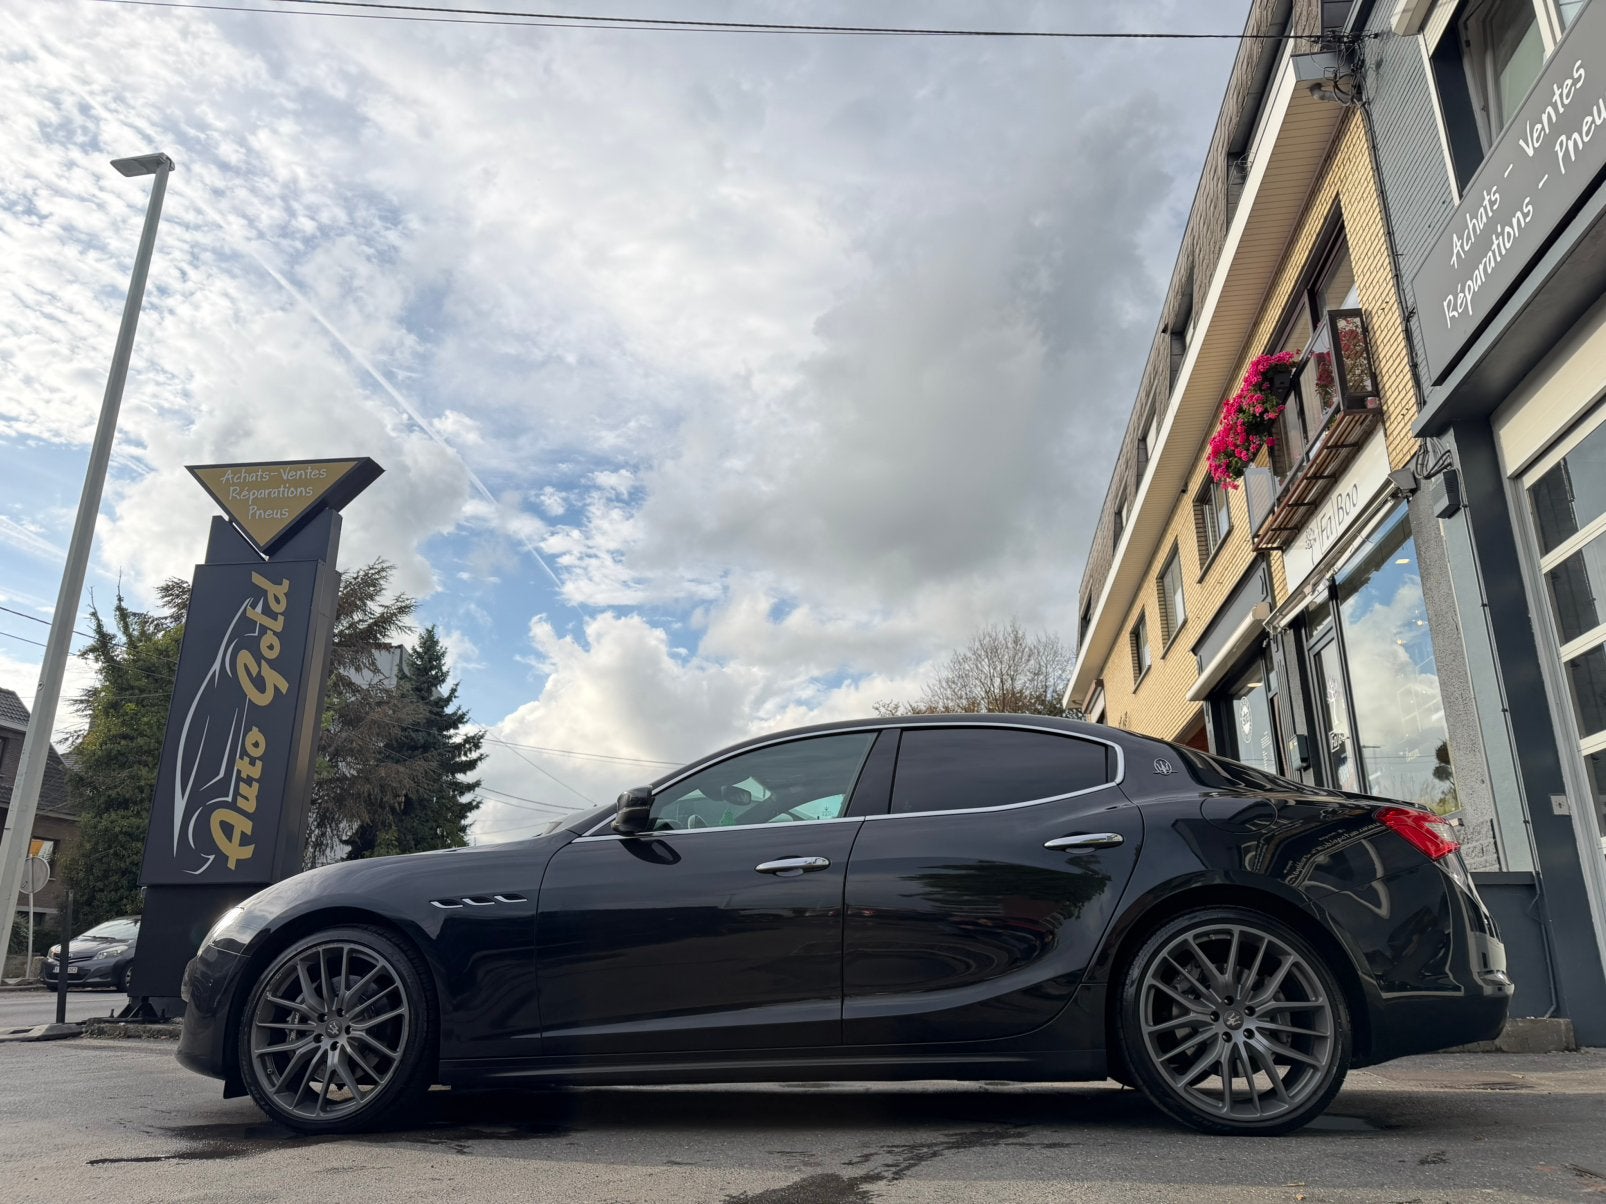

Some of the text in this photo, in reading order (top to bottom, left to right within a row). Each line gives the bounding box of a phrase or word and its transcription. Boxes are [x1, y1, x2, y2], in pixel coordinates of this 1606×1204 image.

[1450, 184, 1500, 270] Achats
[1518, 59, 1586, 158] Ventes
[1442, 196, 1534, 329] Réparations
[228, 483, 314, 504] Réparations
[248, 505, 290, 520] Pneus
[209, 570, 290, 871] Auto Gold
